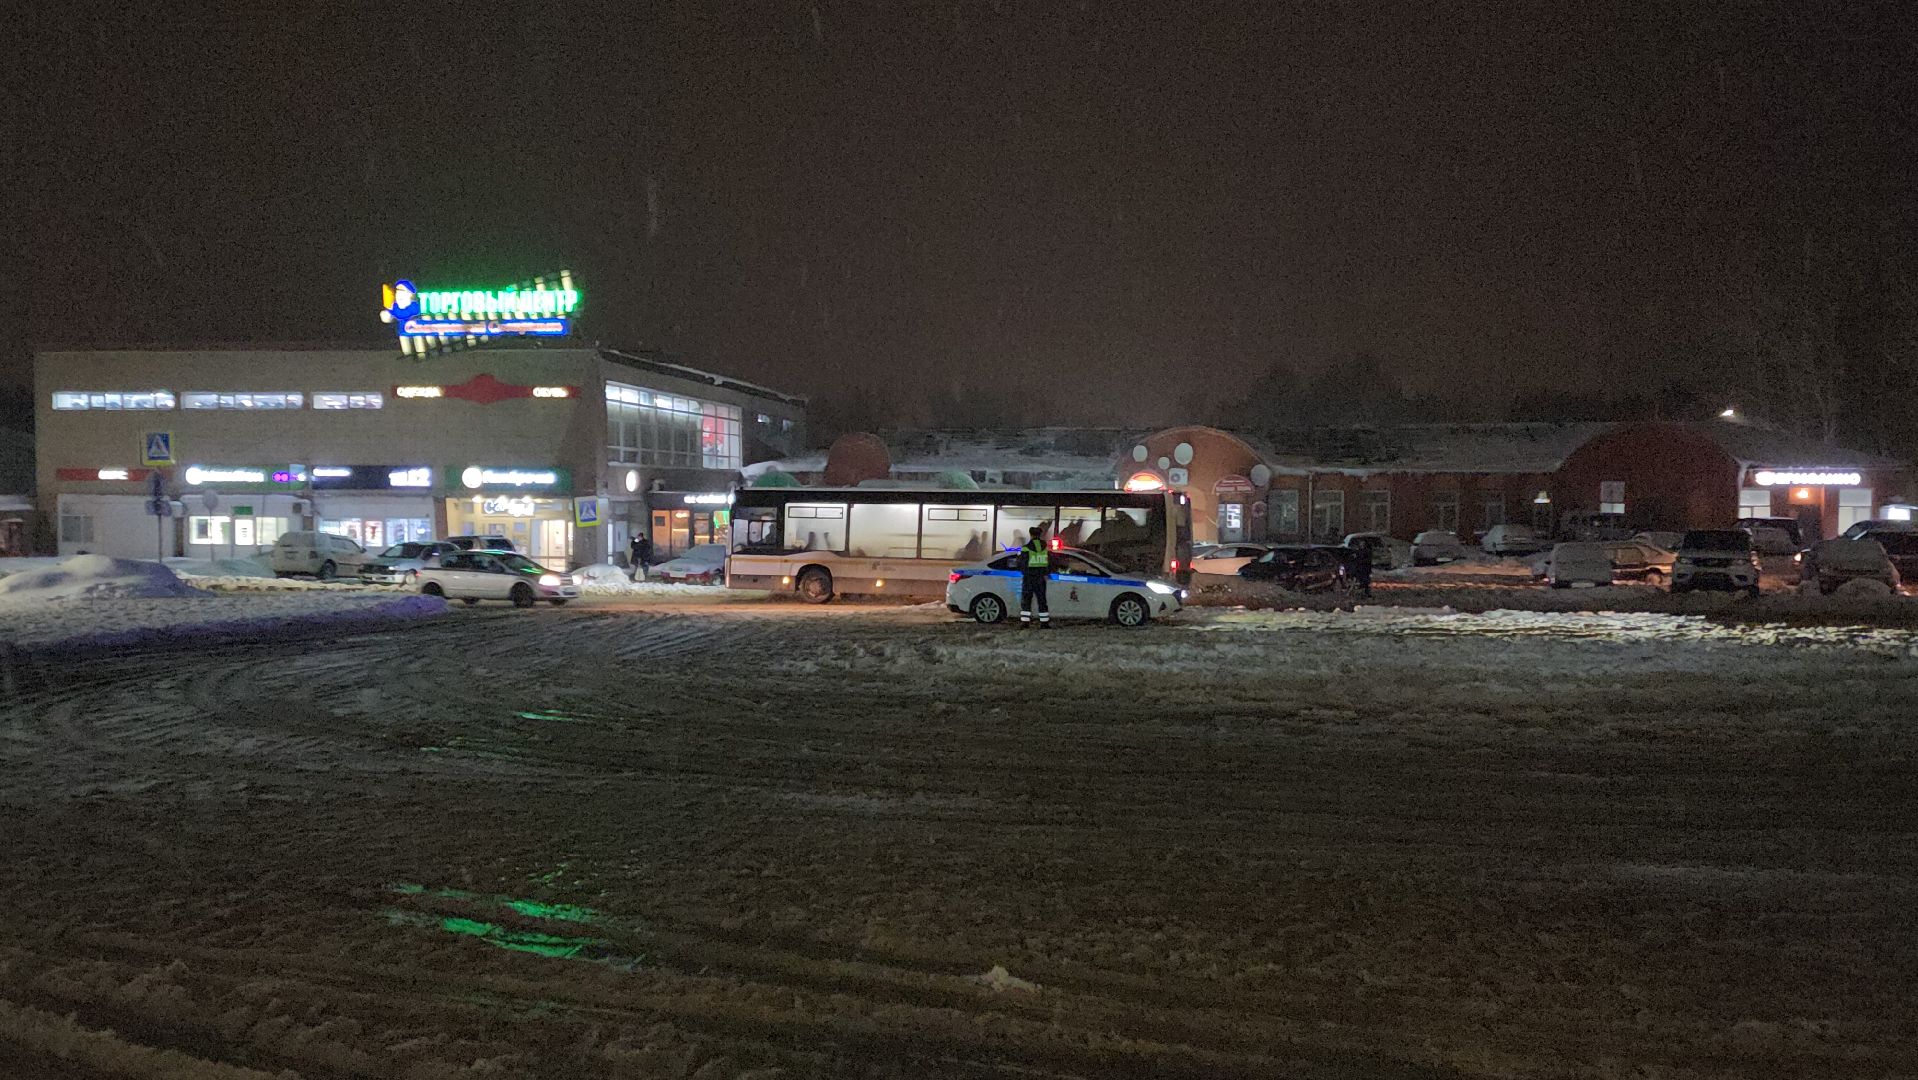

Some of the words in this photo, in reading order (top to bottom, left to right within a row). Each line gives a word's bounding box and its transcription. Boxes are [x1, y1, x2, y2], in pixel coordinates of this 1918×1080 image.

[418, 287, 517, 314] ТОРГОВЫЙ
[518, 289, 578, 314] ЦЕНТР
[1029, 555, 1048, 563] ДПС
